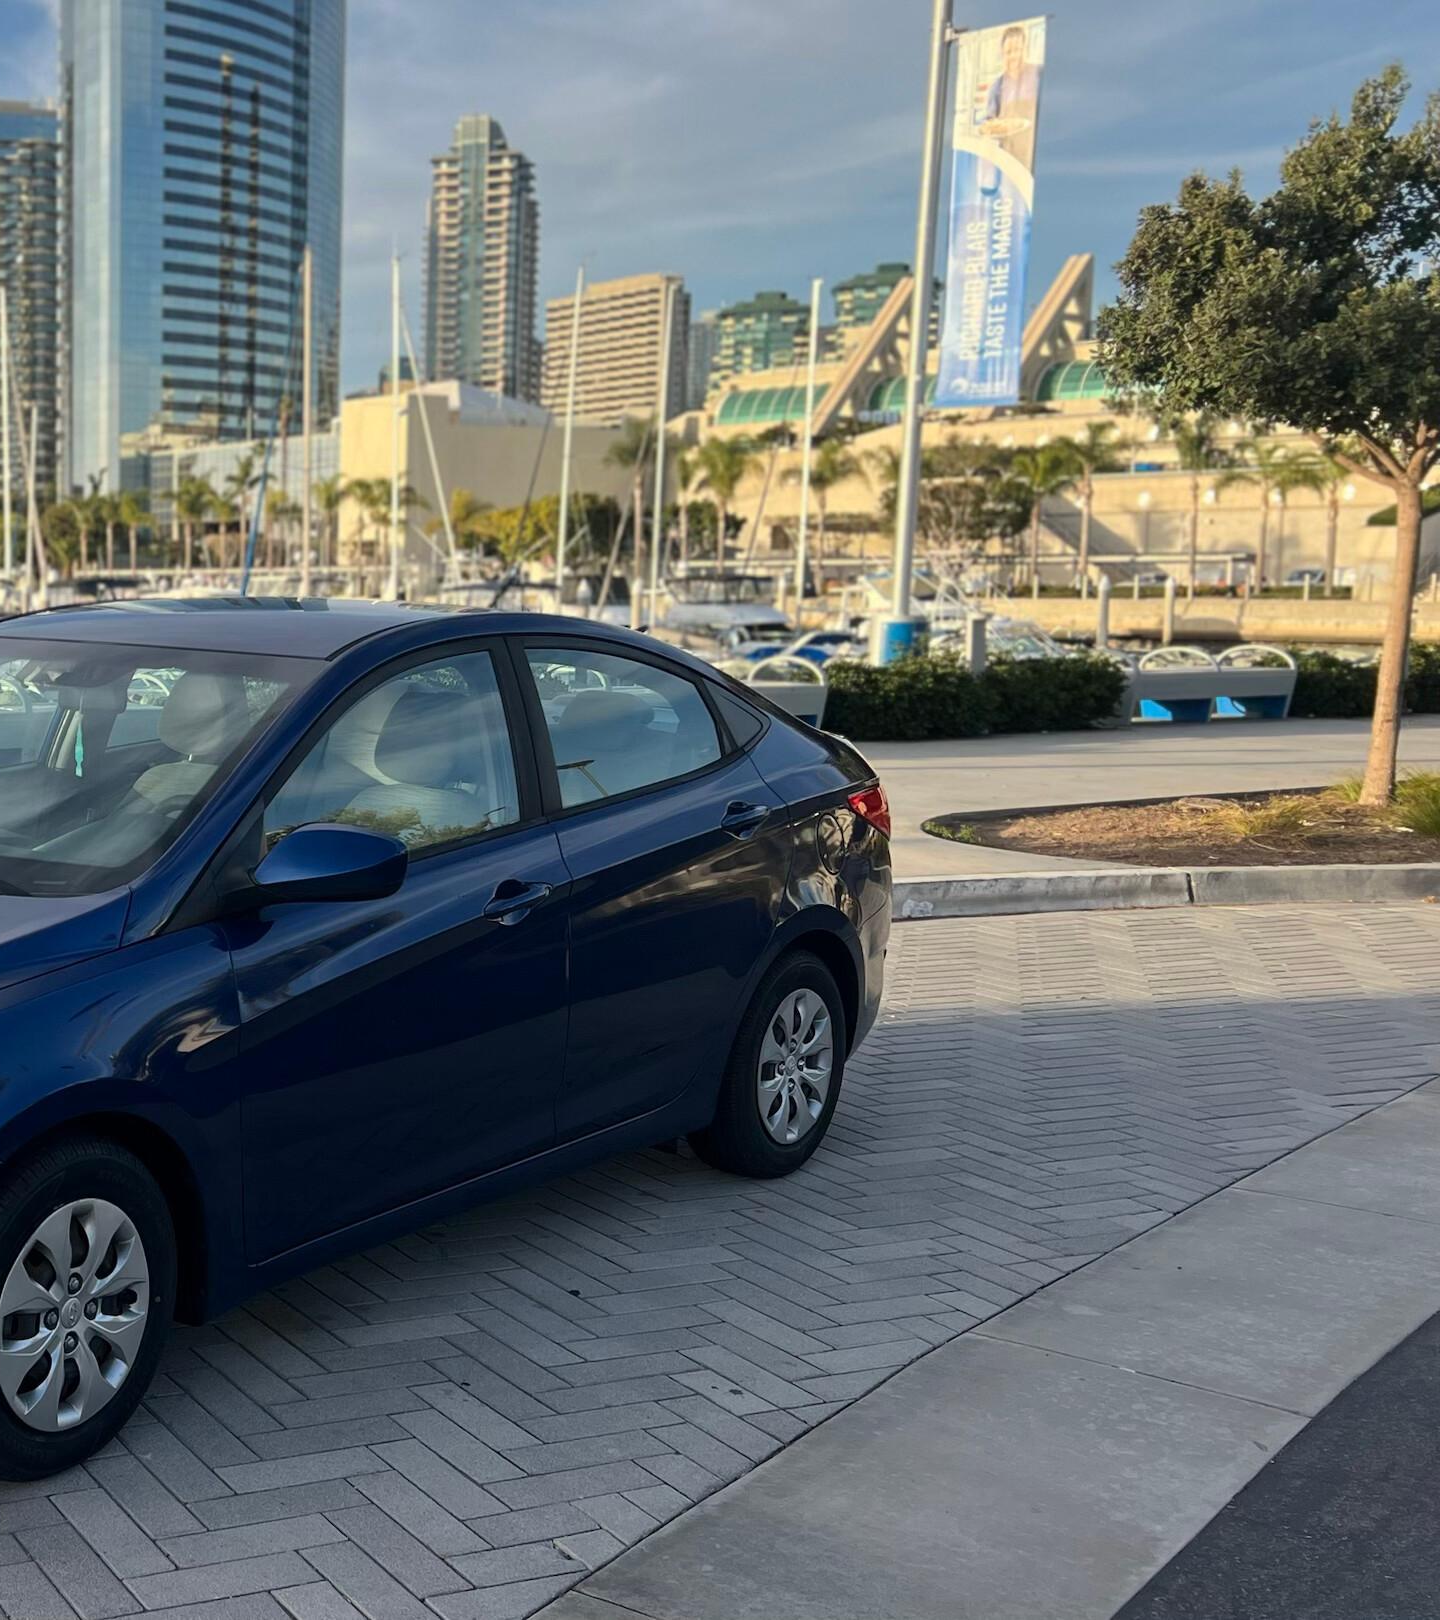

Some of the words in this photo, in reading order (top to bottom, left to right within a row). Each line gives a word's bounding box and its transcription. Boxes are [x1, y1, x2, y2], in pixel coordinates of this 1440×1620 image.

[965, 222, 989, 276] BLAIS
[992, 197, 1014, 259] MAGIC
[990, 262, 1010, 297] THE
[959, 279, 985, 361] RICHARD
[984, 302, 1007, 358] TASTE
